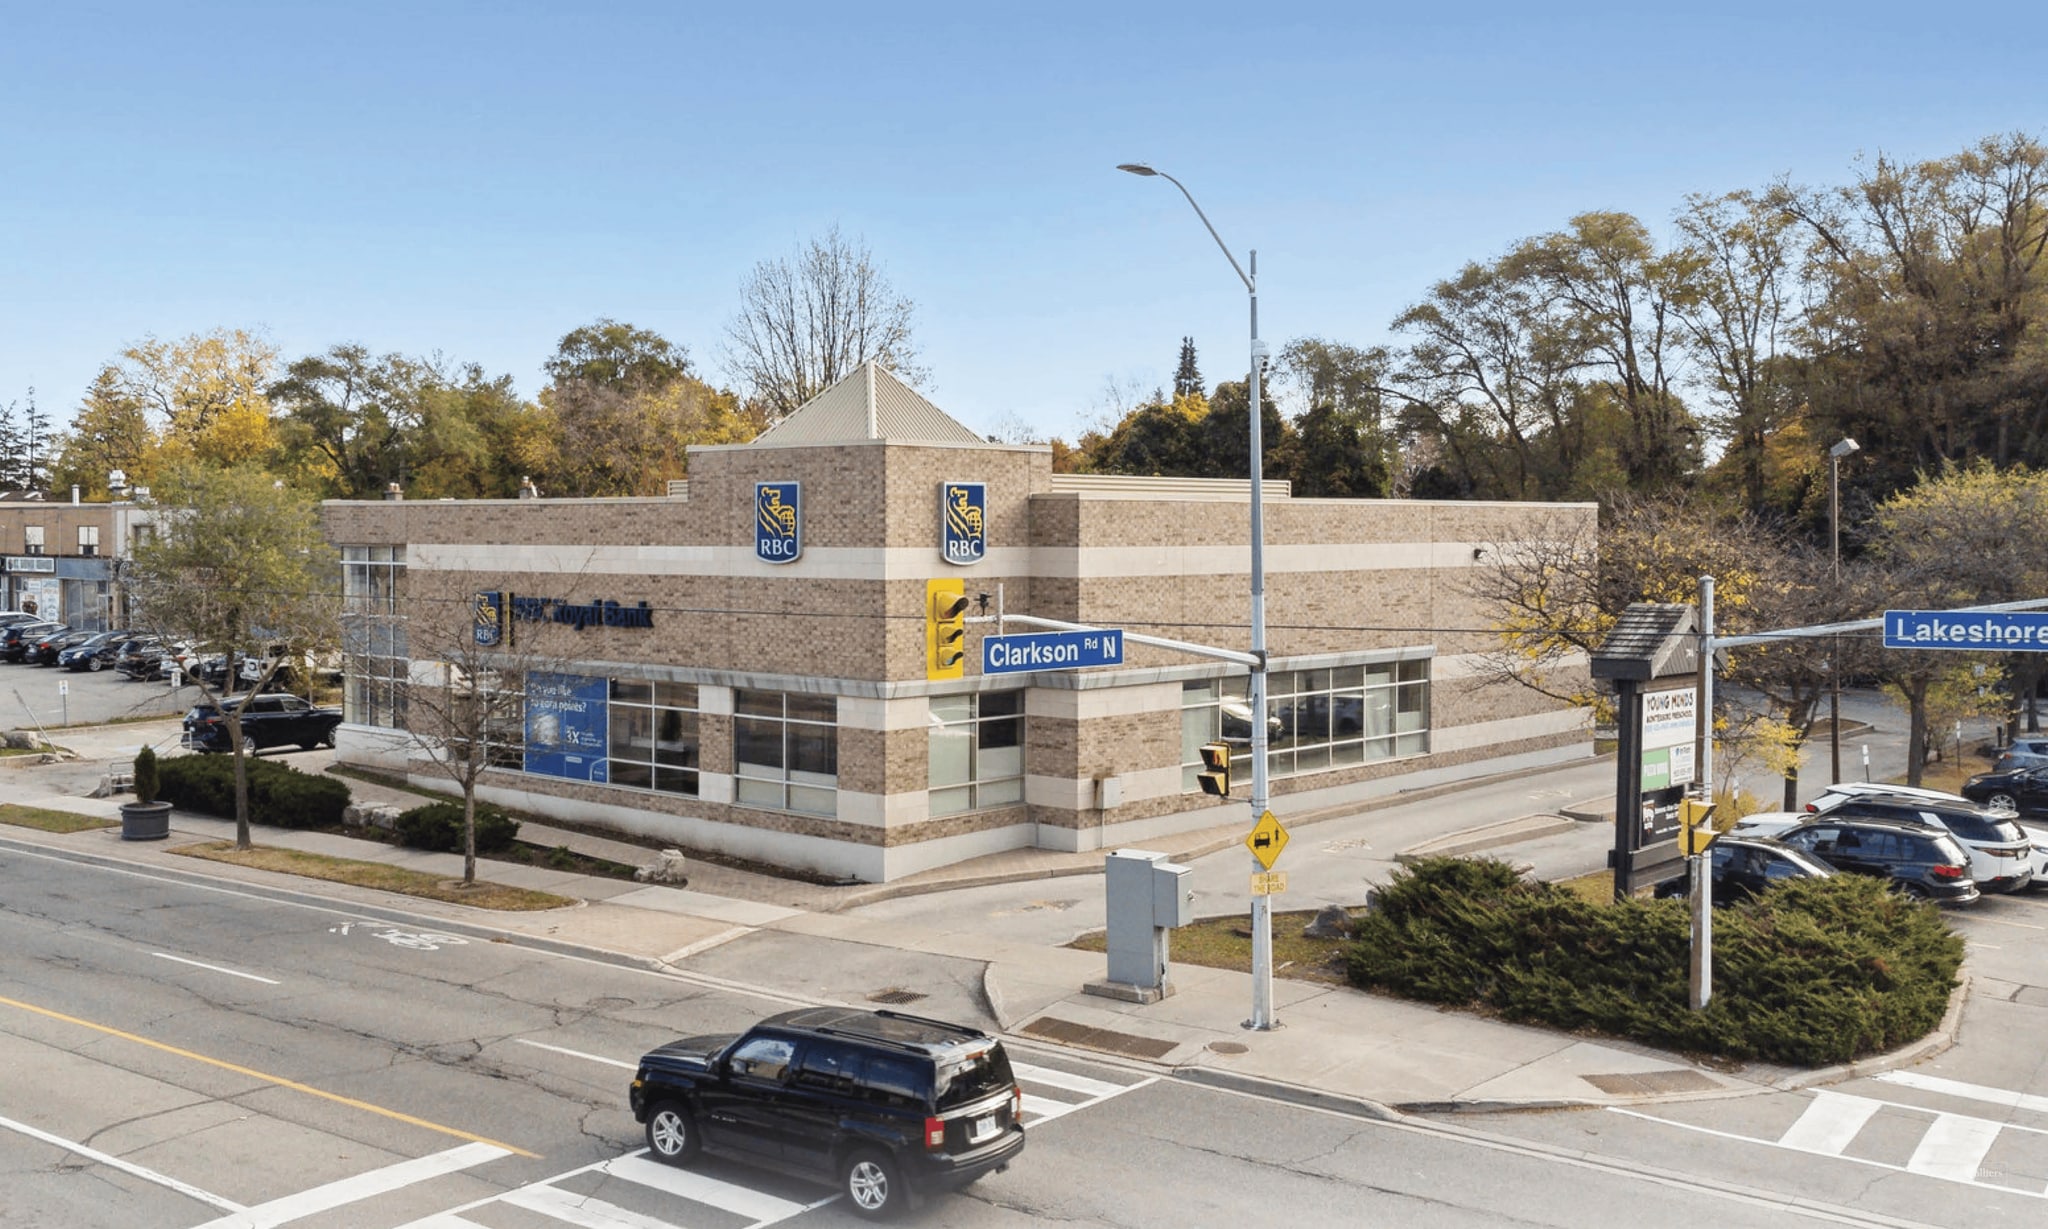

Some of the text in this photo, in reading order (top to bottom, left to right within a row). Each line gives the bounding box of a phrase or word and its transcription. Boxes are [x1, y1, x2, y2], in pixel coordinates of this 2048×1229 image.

[761, 539, 794, 555] RBC
[949, 540, 981, 556] RBC
[604, 600, 655, 628] Bank
[1897, 618, 2048, 644] Lakeshore
[989, 635, 1116, 667] Clarkson Rd N
[1646, 692, 1693, 711] YOUNG MINDS
